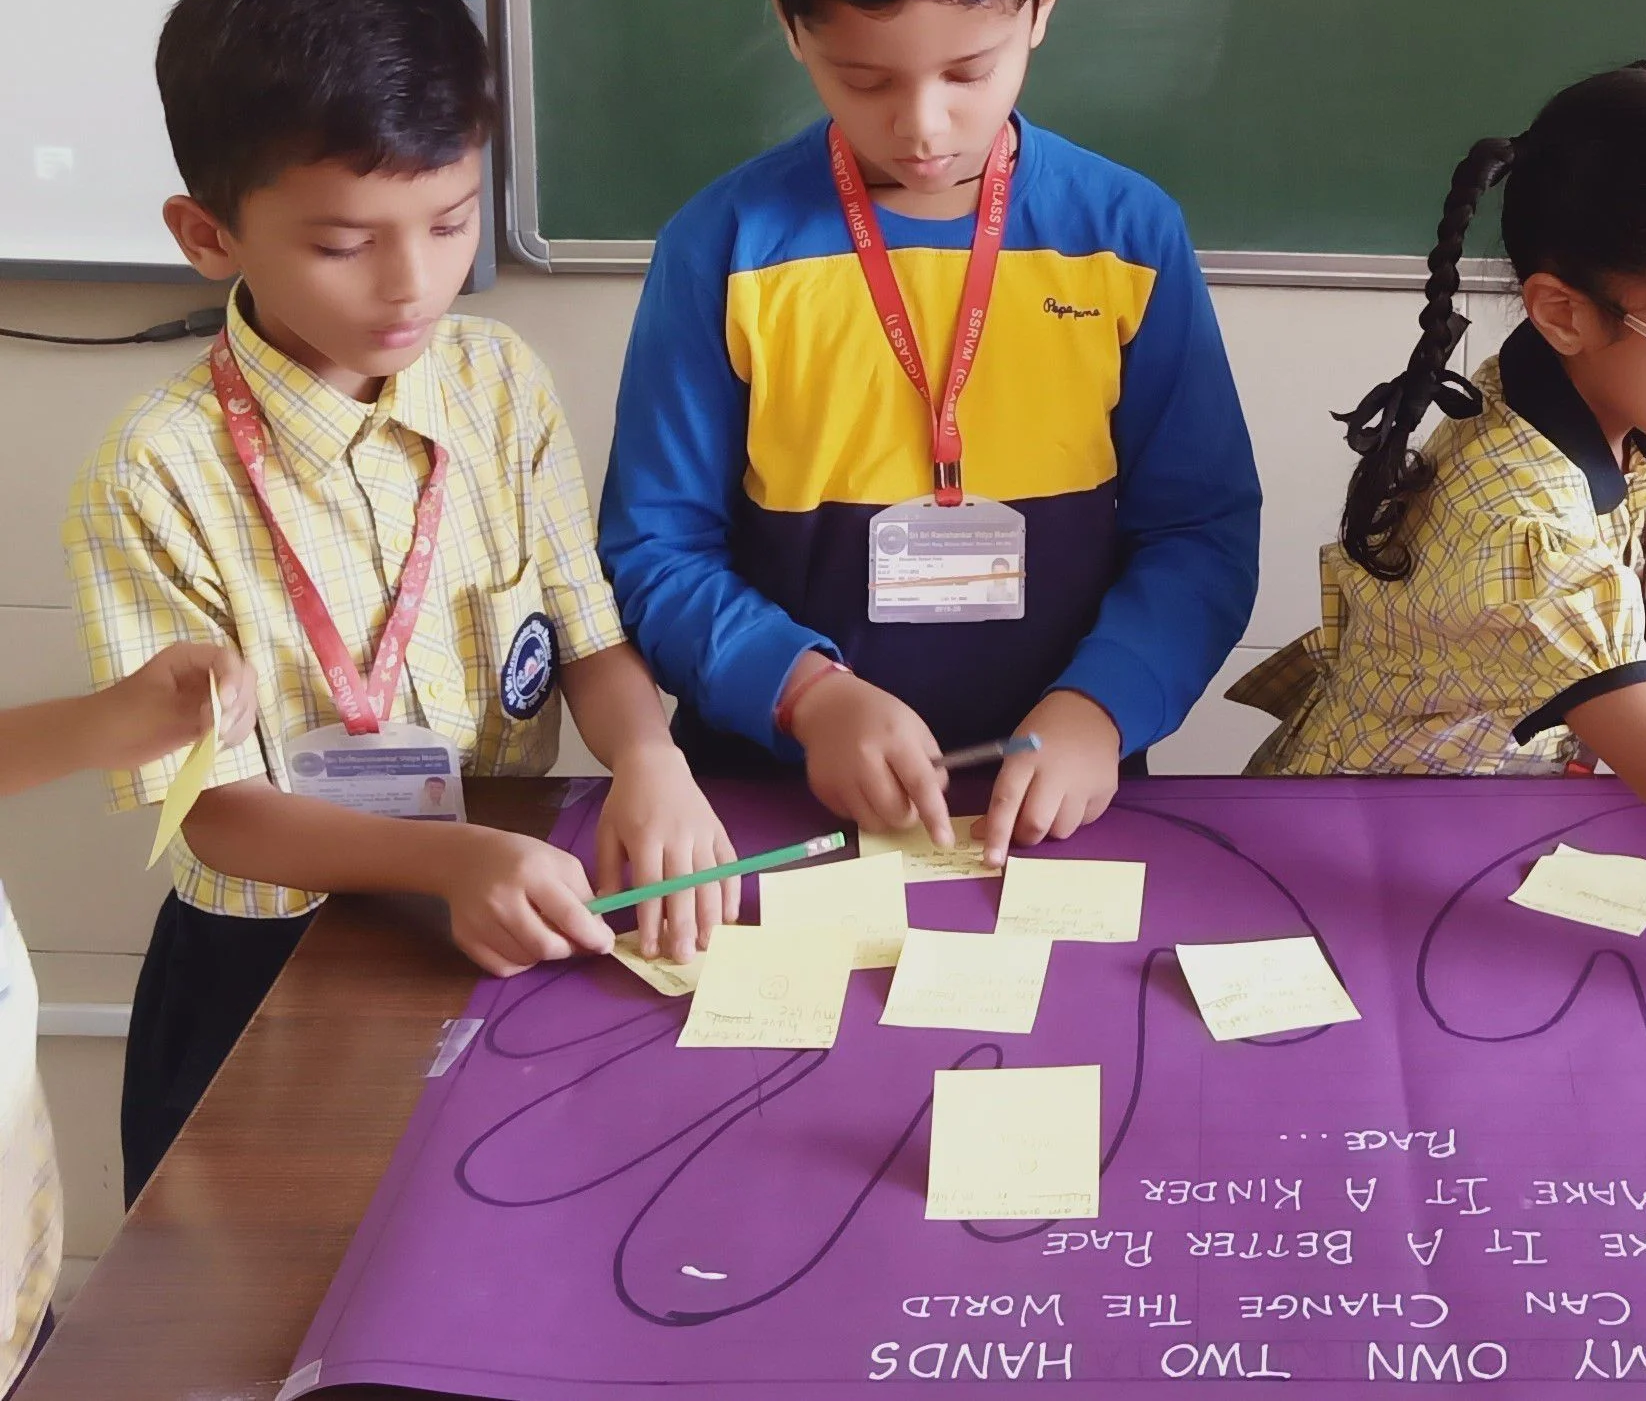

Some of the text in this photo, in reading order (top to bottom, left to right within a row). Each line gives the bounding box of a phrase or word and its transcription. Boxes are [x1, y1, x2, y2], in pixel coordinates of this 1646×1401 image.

[988, 178, 1006, 223] (CLASS
[846, 201, 872, 250] SSRVM
[889, 327, 921, 379] (CLASS
[959, 307, 984, 362] SSRVM
[946, 367, 967, 423] (CLASS
[327, 665, 362, 721] SSRVM
[1140, 1177, 1303, 1211] KINDER
[1345, 1177, 1377, 1213] A
[1424, 1177, 1492, 1215] IT
[1042, 1231, 1153, 1268] PLACE
[1186, 1231, 1353, 1265] BETTER
[1406, 1229, 1443, 1266] A
[1484, 1229, 1548, 1265] IT
[901, 1294, 1065, 1327] WORLD
[1101, 1294, 1192, 1328] THE
[1238, 1294, 1450, 1329] CHANGE
[1525, 1292, 1631, 1327] CAN
[868, 1341, 1073, 1381] HANDS
[1161, 1343, 1291, 1381] TWO
[1367, 1341, 1508, 1383] OWN
